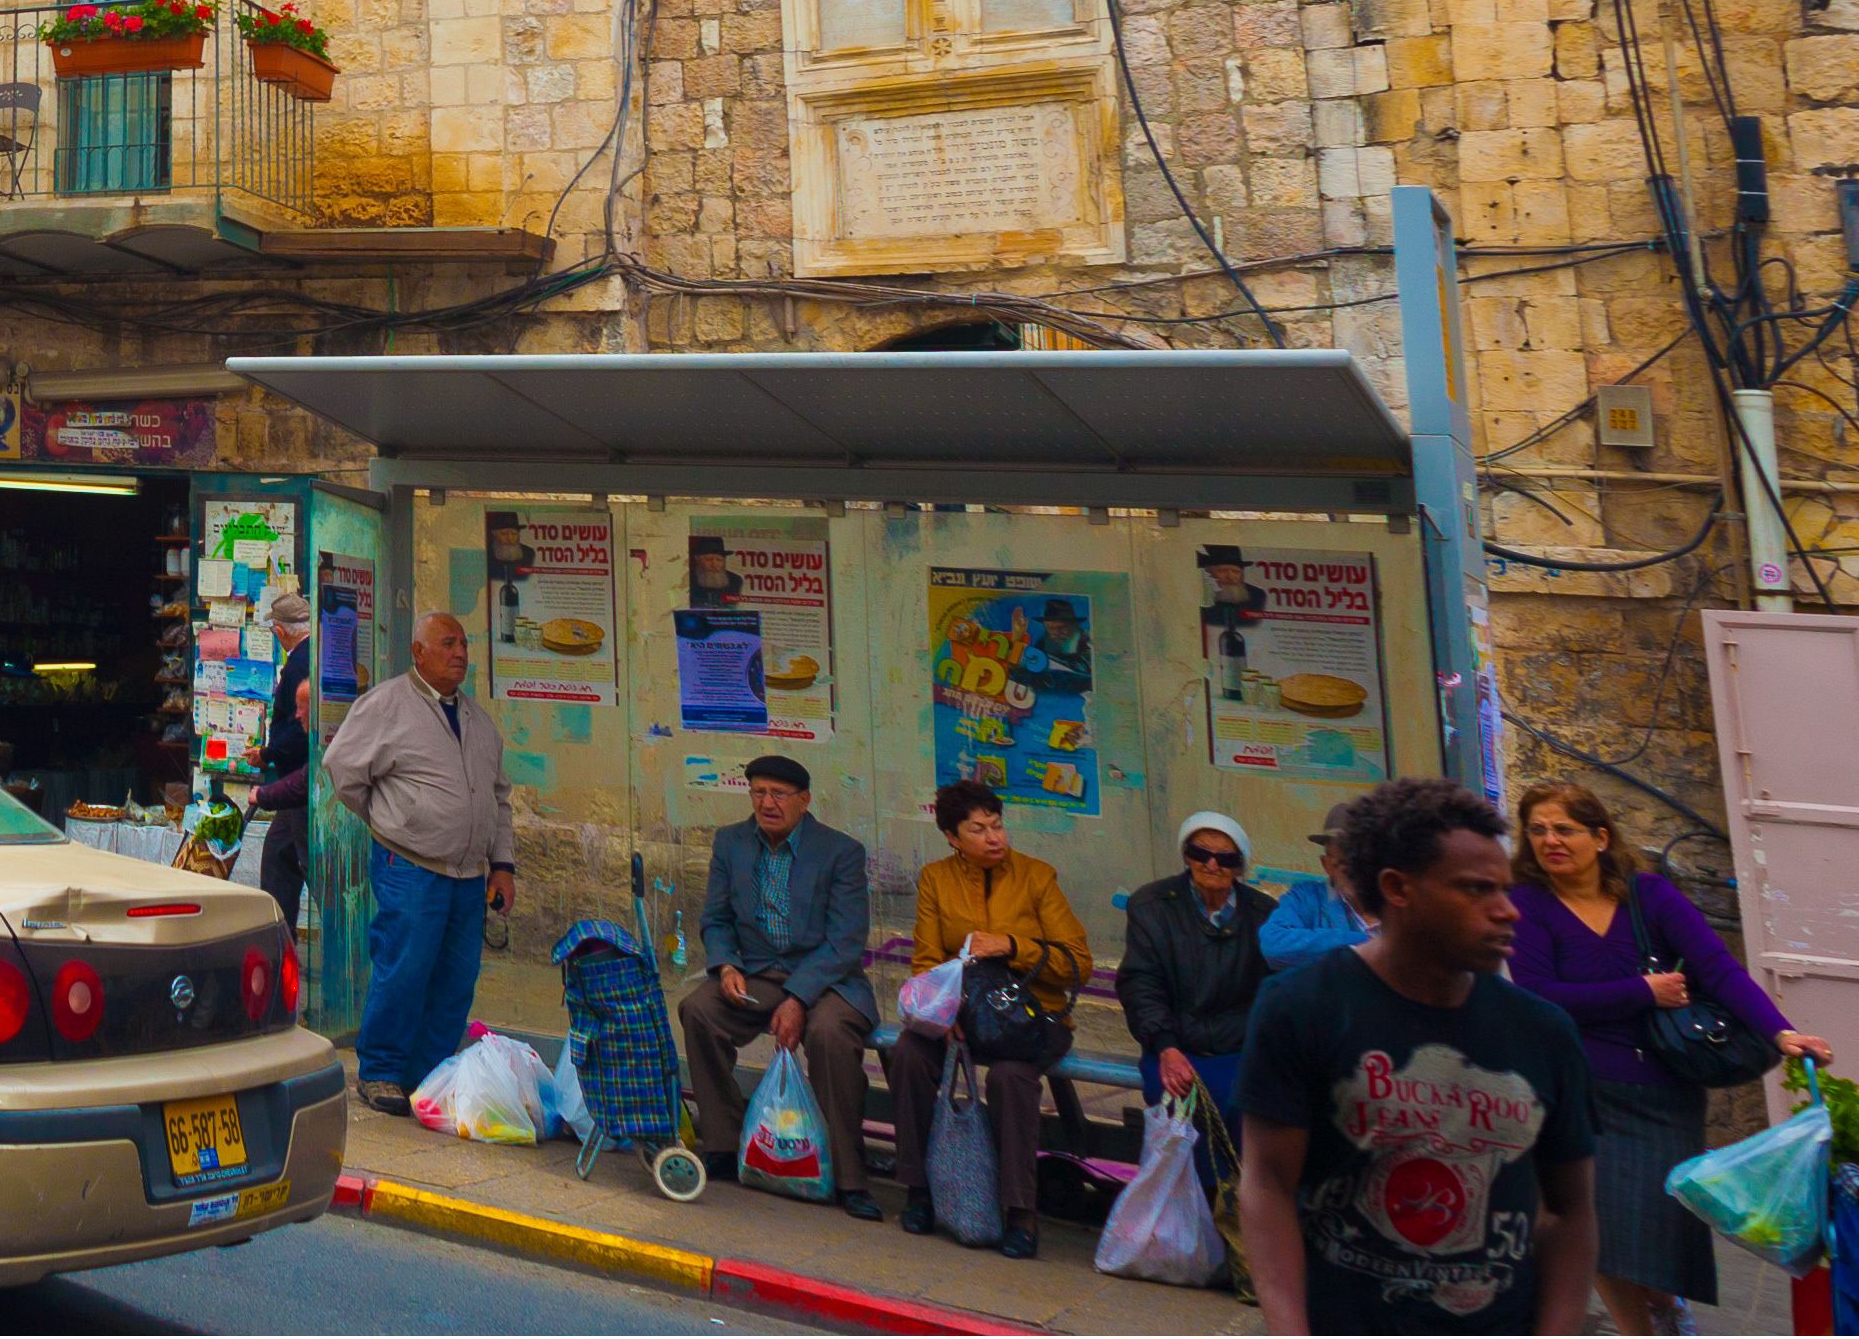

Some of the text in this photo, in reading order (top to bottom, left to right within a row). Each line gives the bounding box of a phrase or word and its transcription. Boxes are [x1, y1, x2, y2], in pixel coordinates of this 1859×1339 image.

[131, 414, 161, 428] כשר
[528, 524, 608, 542] עושים סדר
[536, 543, 609, 564] בליל הסדר
[735, 550, 823, 570] עושים סדר
[744, 572, 824, 594] בליל הסדר
[1256, 561, 1368, 585] עושים סדר
[1267, 587, 1370, 611] בליל הסדר
[1347, 1101, 1441, 1137] JEANS
[169, 1108, 241, 1155] 66-587-58
